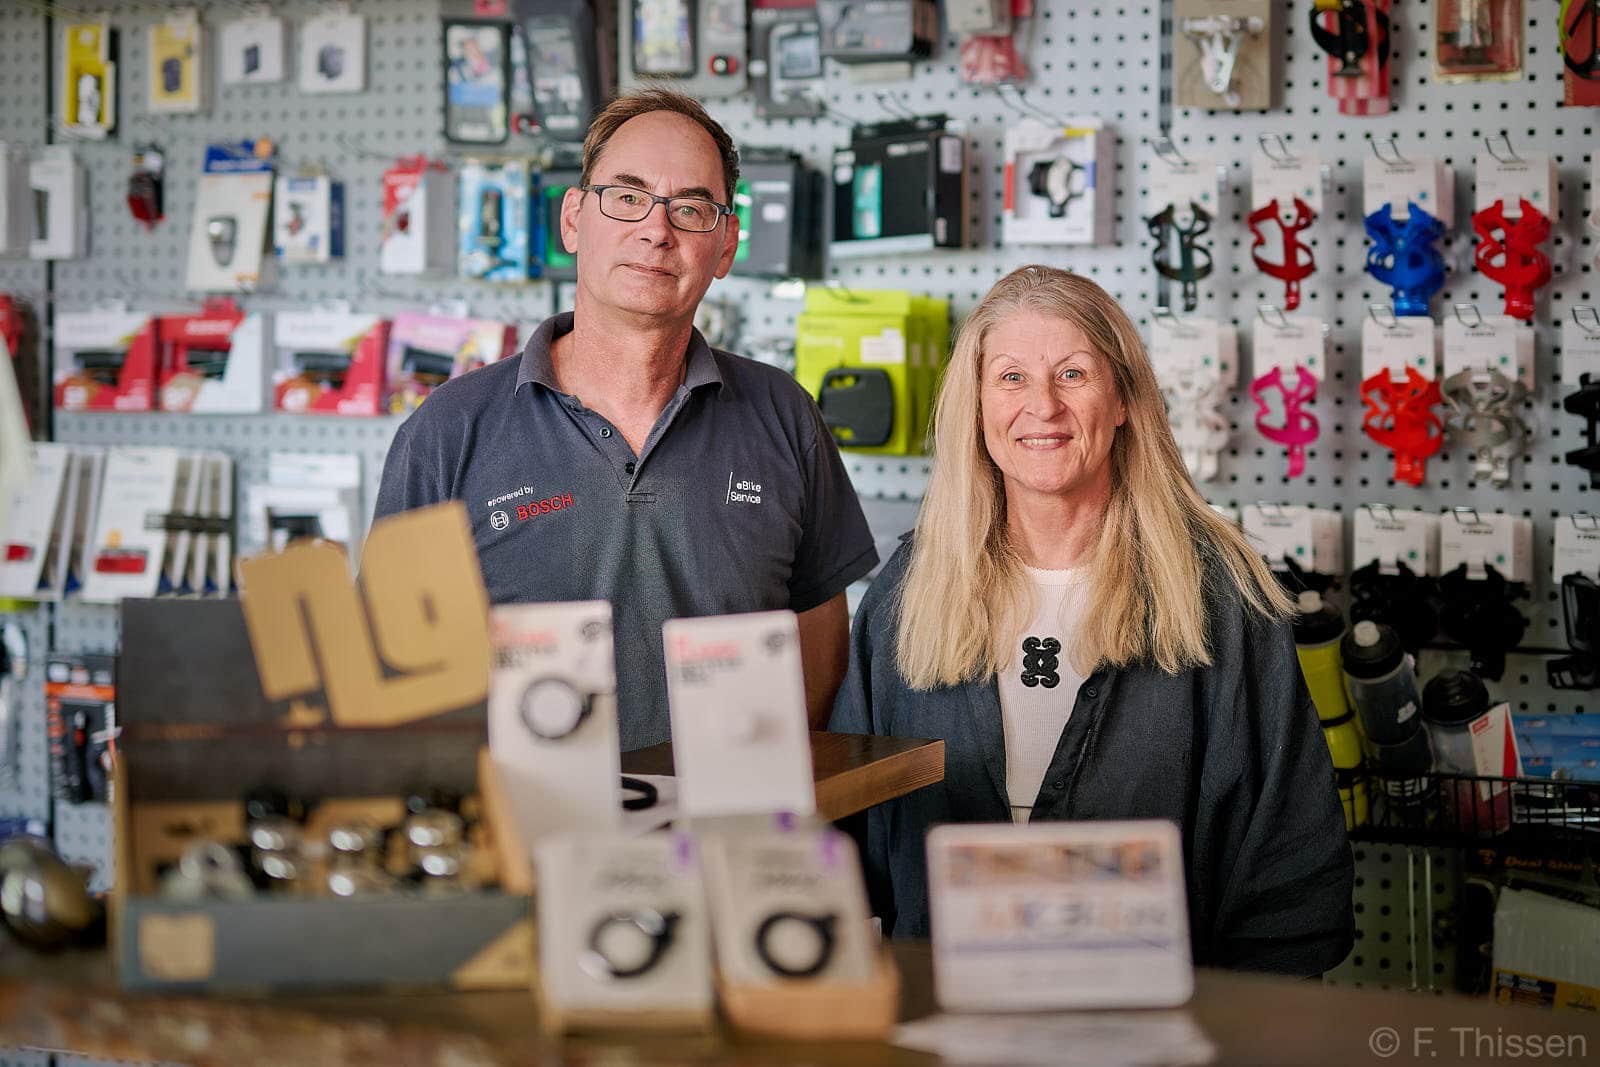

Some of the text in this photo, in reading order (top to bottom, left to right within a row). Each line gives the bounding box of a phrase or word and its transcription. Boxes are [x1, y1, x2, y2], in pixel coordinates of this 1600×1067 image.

[736, 480, 762, 493] eBike
[487, 485, 534, 507] epowered by
[730, 491, 761, 505] Service
[516, 492, 574, 521] BOSCH
